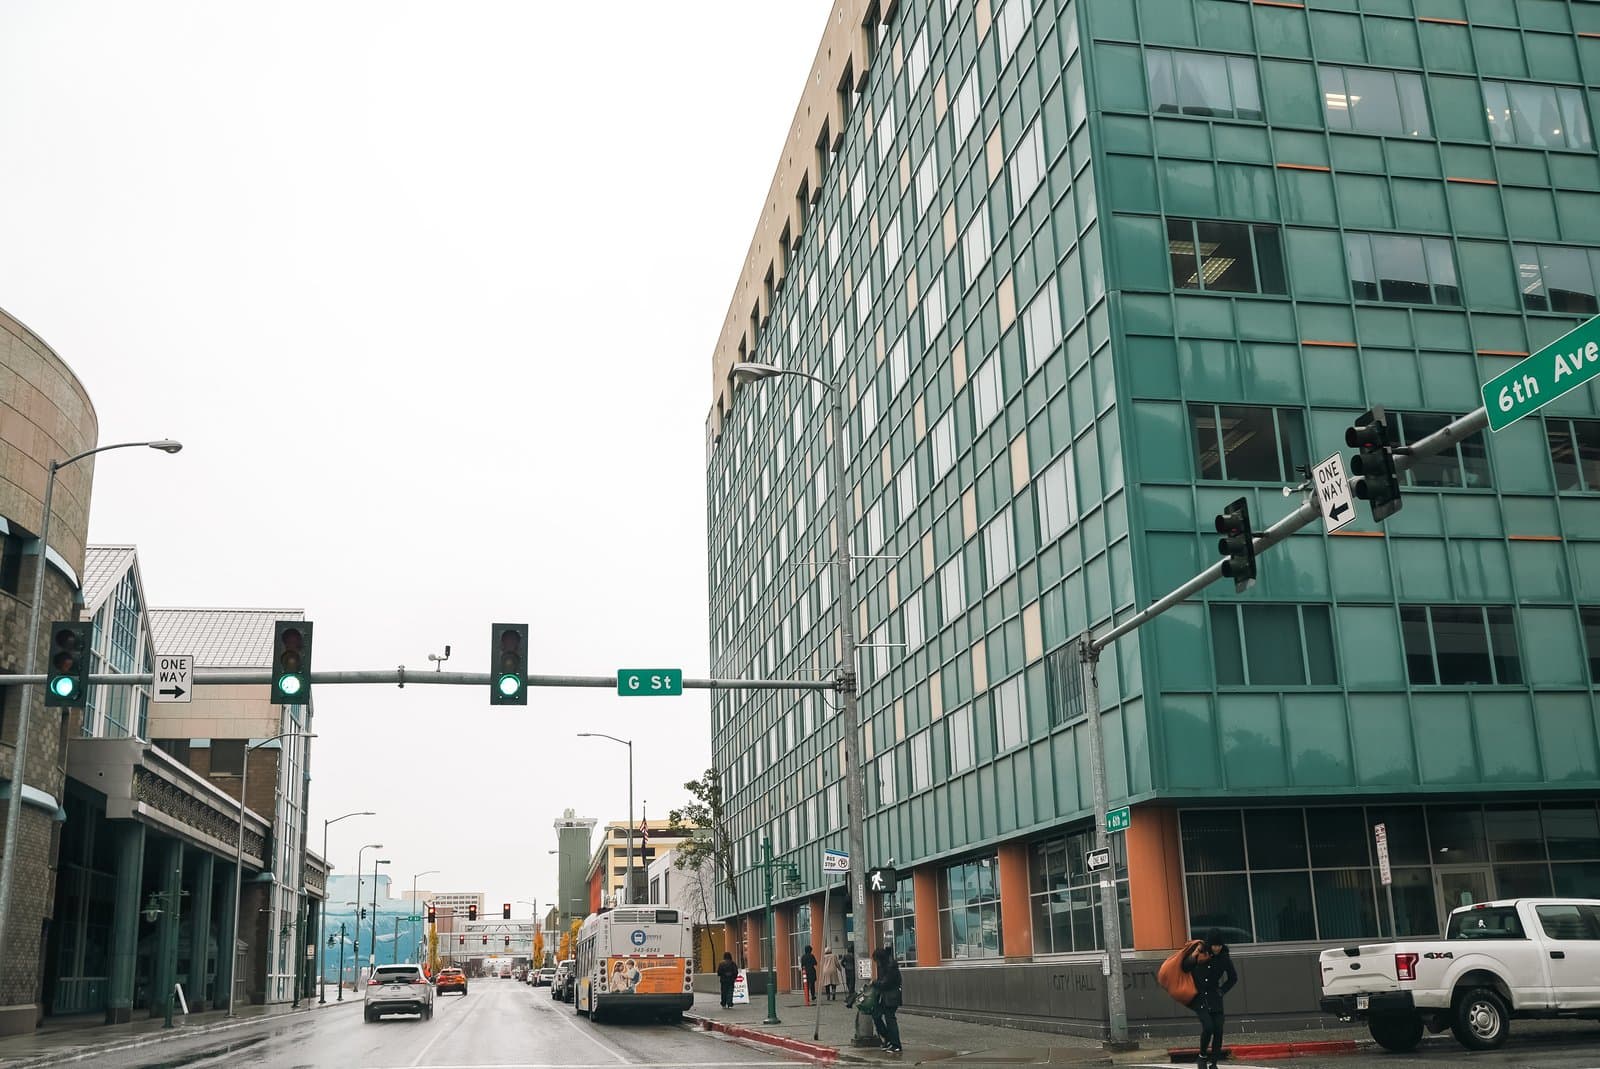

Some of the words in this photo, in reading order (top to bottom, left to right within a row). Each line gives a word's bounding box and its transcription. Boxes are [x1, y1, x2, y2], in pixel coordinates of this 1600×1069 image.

[1498, 374, 1540, 412] 6th
[1554, 341, 1599, 383] Ave
[1318, 461, 1339, 484] ONE
[1321, 479, 1343, 502] WAY
[161, 659, 187, 670] ONE
[160, 671, 187, 682] WAY
[628, 675, 640, 690] G
[650, 675, 671, 690] St
[1053, 974, 1070, 991] CITY
[1075, 974, 1097, 991] HALL
